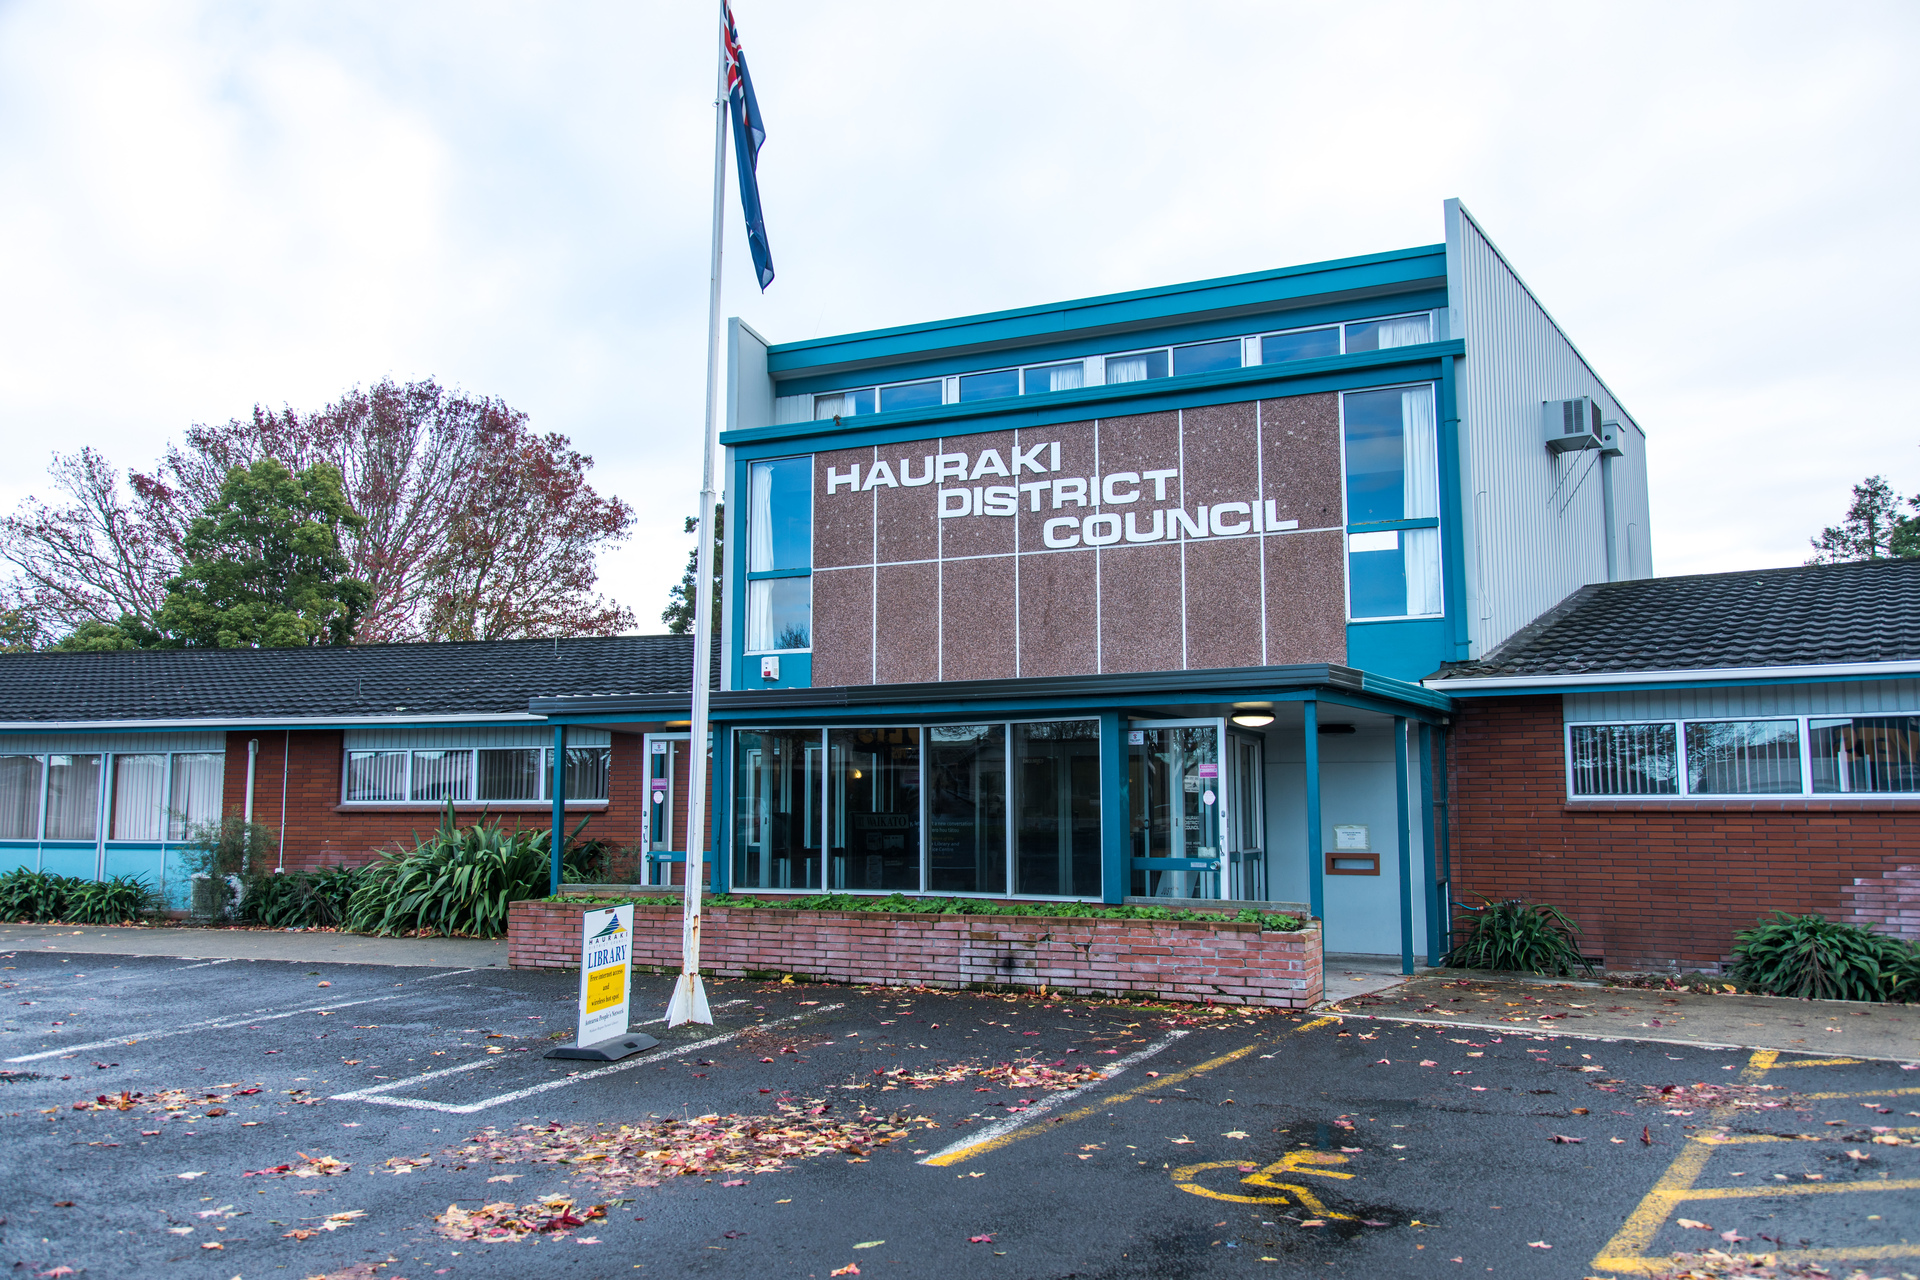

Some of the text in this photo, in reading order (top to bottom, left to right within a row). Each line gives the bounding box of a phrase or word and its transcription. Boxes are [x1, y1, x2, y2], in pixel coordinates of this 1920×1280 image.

[827, 441, 1061, 495] HAURAKI
[938, 468, 1178, 519] DISTRICT
[1044, 500, 1299, 549] COUNCIL
[867, 816, 906, 827] WAIKATO
[588, 932, 628, 945] HAURAKI
[587, 944, 628, 969] LIBRARY
[590, 974, 598, 982] Free
[598, 971, 612, 980] internet
[602, 982, 610, 991] and
[591, 997, 605, 1006] wireless
